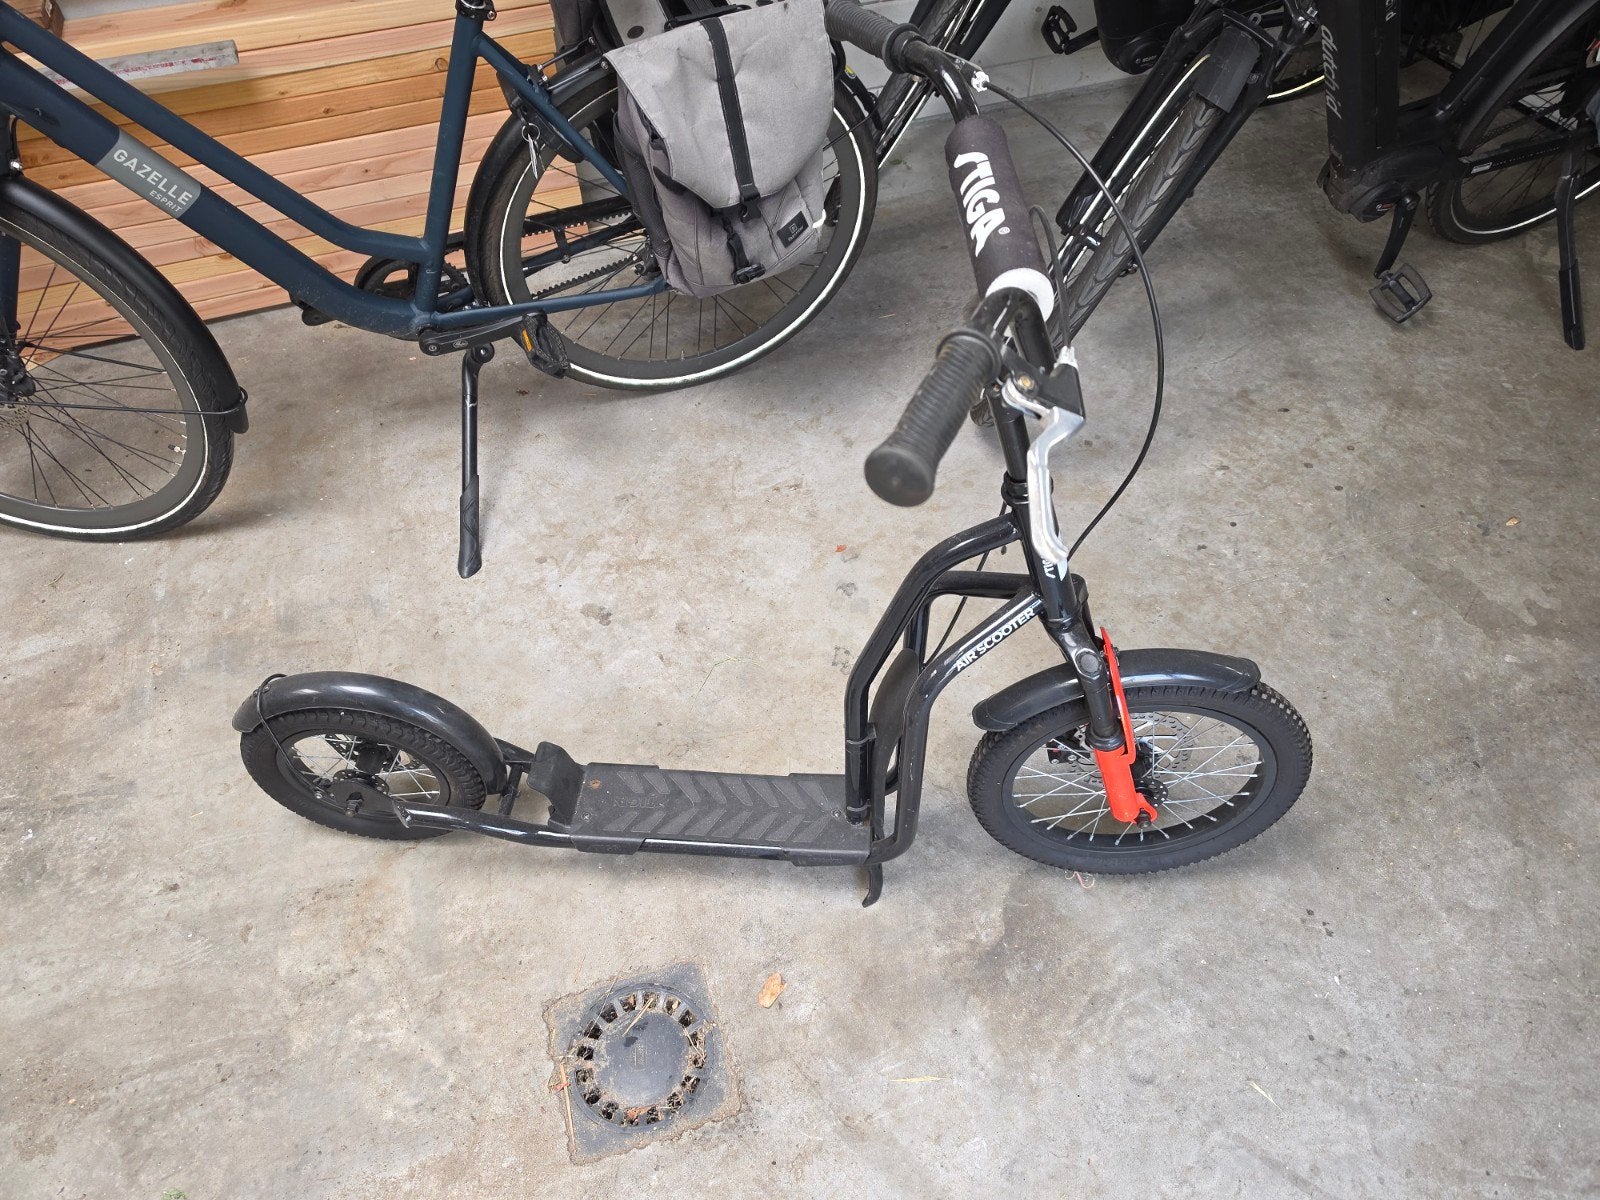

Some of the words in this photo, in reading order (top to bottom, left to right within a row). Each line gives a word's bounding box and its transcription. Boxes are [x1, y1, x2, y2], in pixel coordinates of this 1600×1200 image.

[113, 149, 193, 205] GAZELLE
[149, 190, 182, 212] ESPRIT
[955, 650, 978, 671] AIR
[977, 606, 1036, 655] SCOOTER
